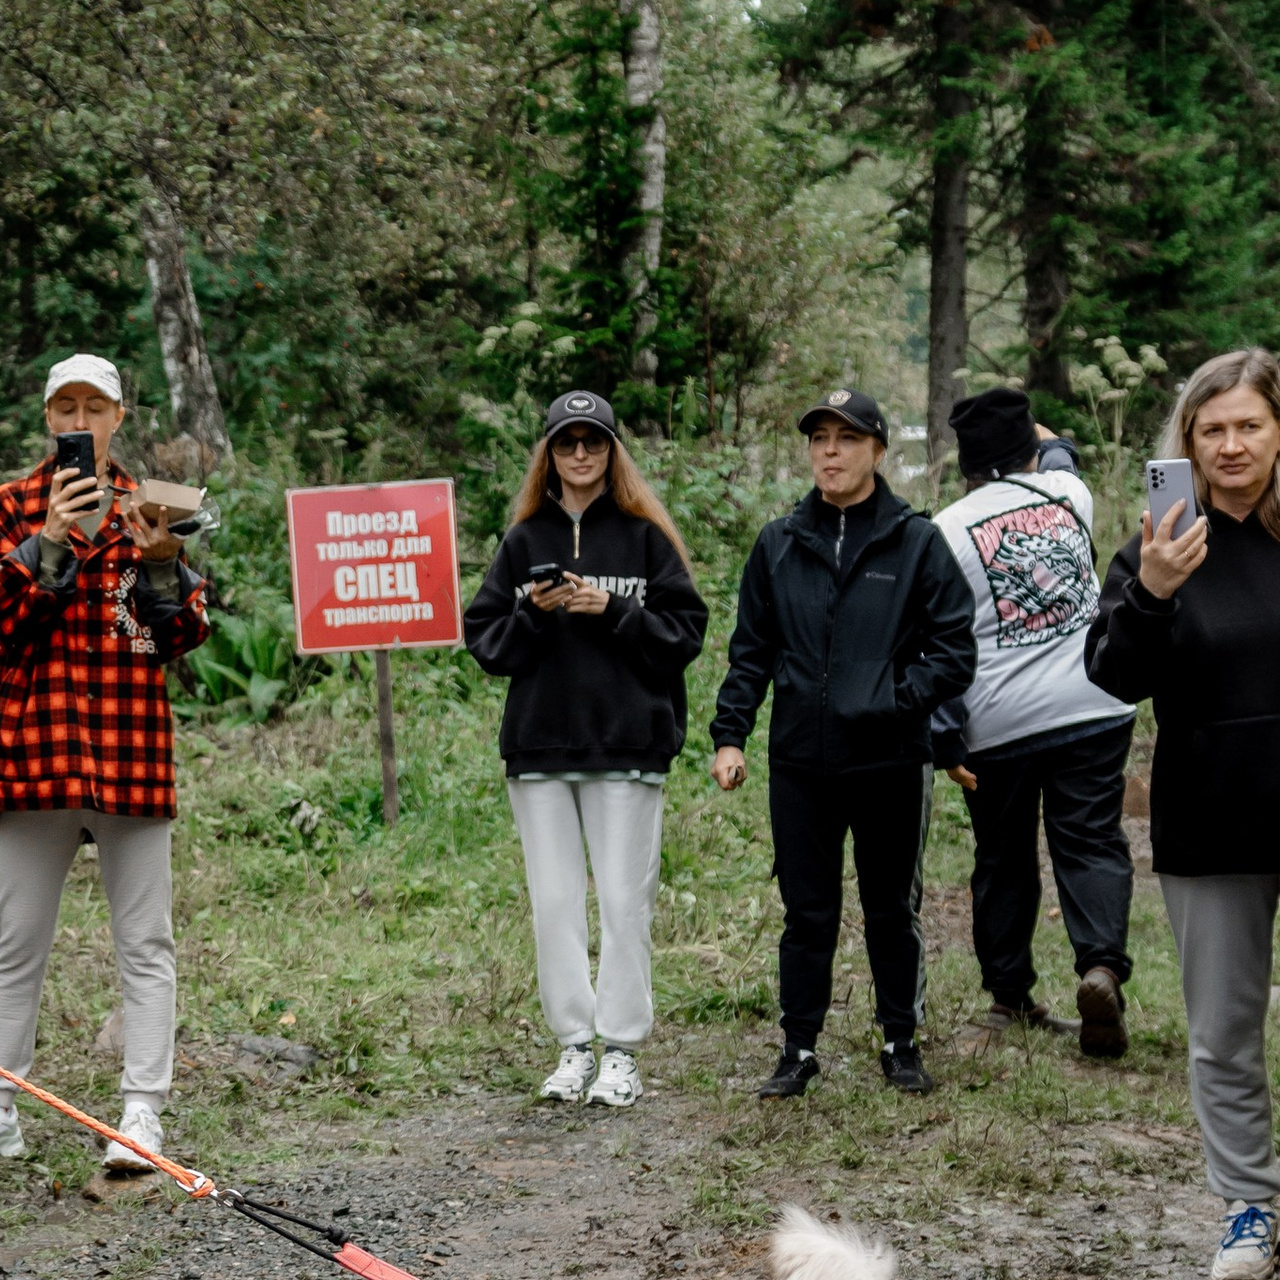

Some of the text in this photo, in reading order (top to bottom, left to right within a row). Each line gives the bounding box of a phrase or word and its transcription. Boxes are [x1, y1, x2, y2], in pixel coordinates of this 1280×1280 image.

[325, 509, 418, 538] Проезд
[316, 535, 432, 562] только для
[334, 561, 420, 602] СПЕЦ
[322, 601, 434, 627] транспорта
[130, 638, 158, 654] 196
